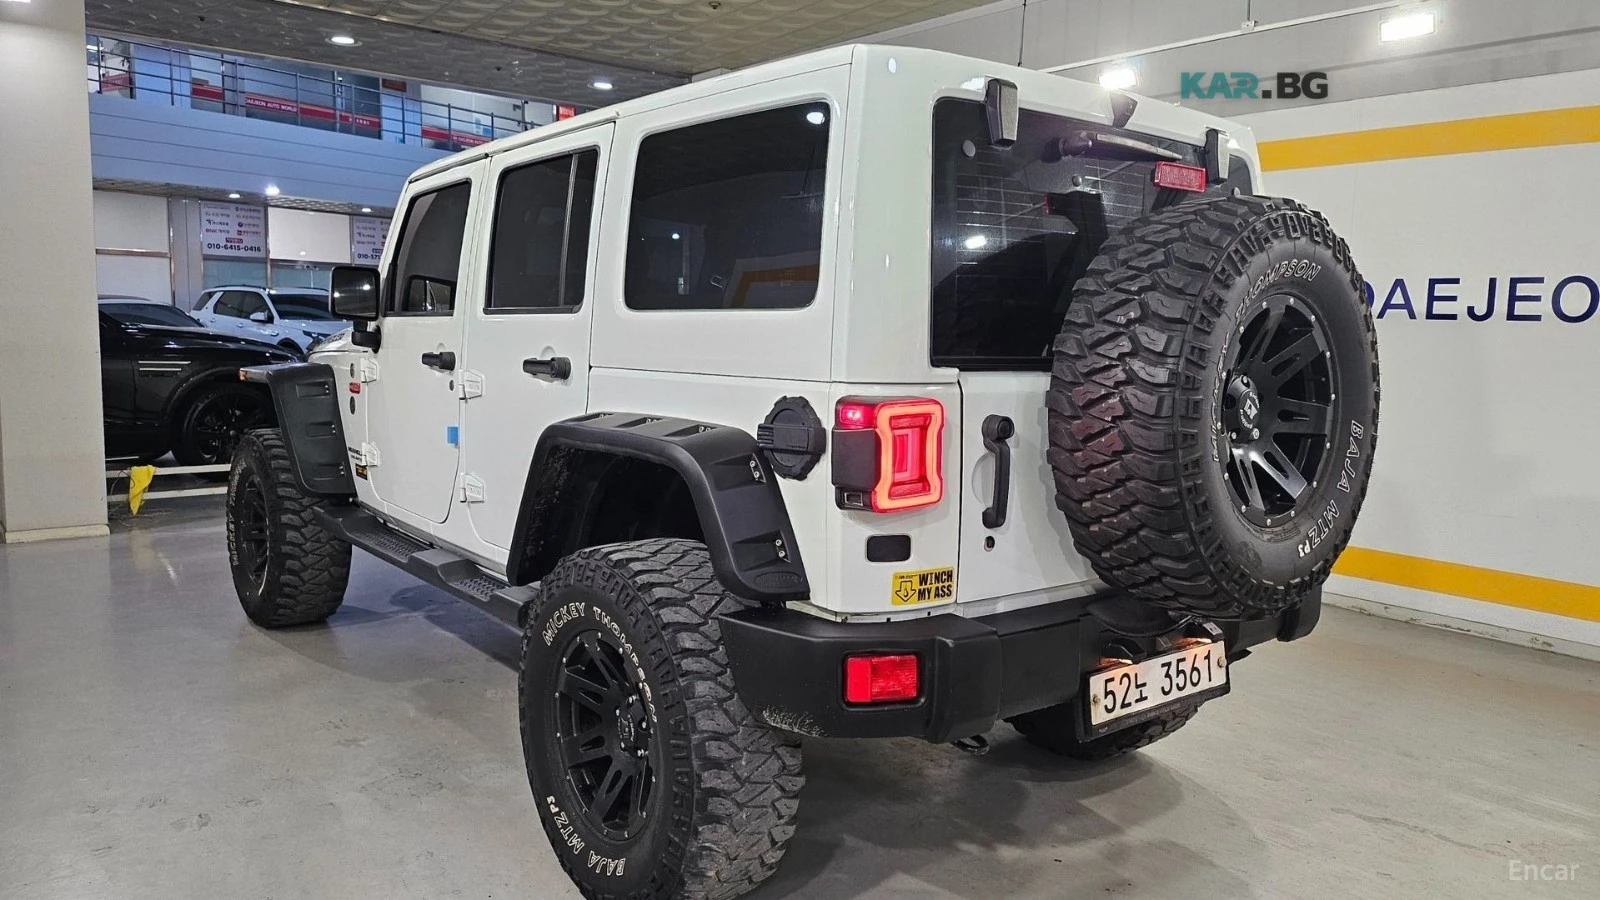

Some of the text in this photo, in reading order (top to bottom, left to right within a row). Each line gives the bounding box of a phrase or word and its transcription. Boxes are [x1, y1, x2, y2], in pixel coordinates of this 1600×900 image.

[207, 243, 261, 252] 010-6415-0416
[1235, 259, 1321, 325] THOMPSON
[1365, 276, 1600, 323] AEJEO
[1337, 420, 1364, 492] BAJA
[918, 570, 953, 586] WINCH
[918, 584, 952, 601] MY ASS
[542, 602, 657, 723] MICKEY THOMPSON
[1104, 650, 1212, 713] 52노 3561
[588, 850, 626, 876] BAJA
